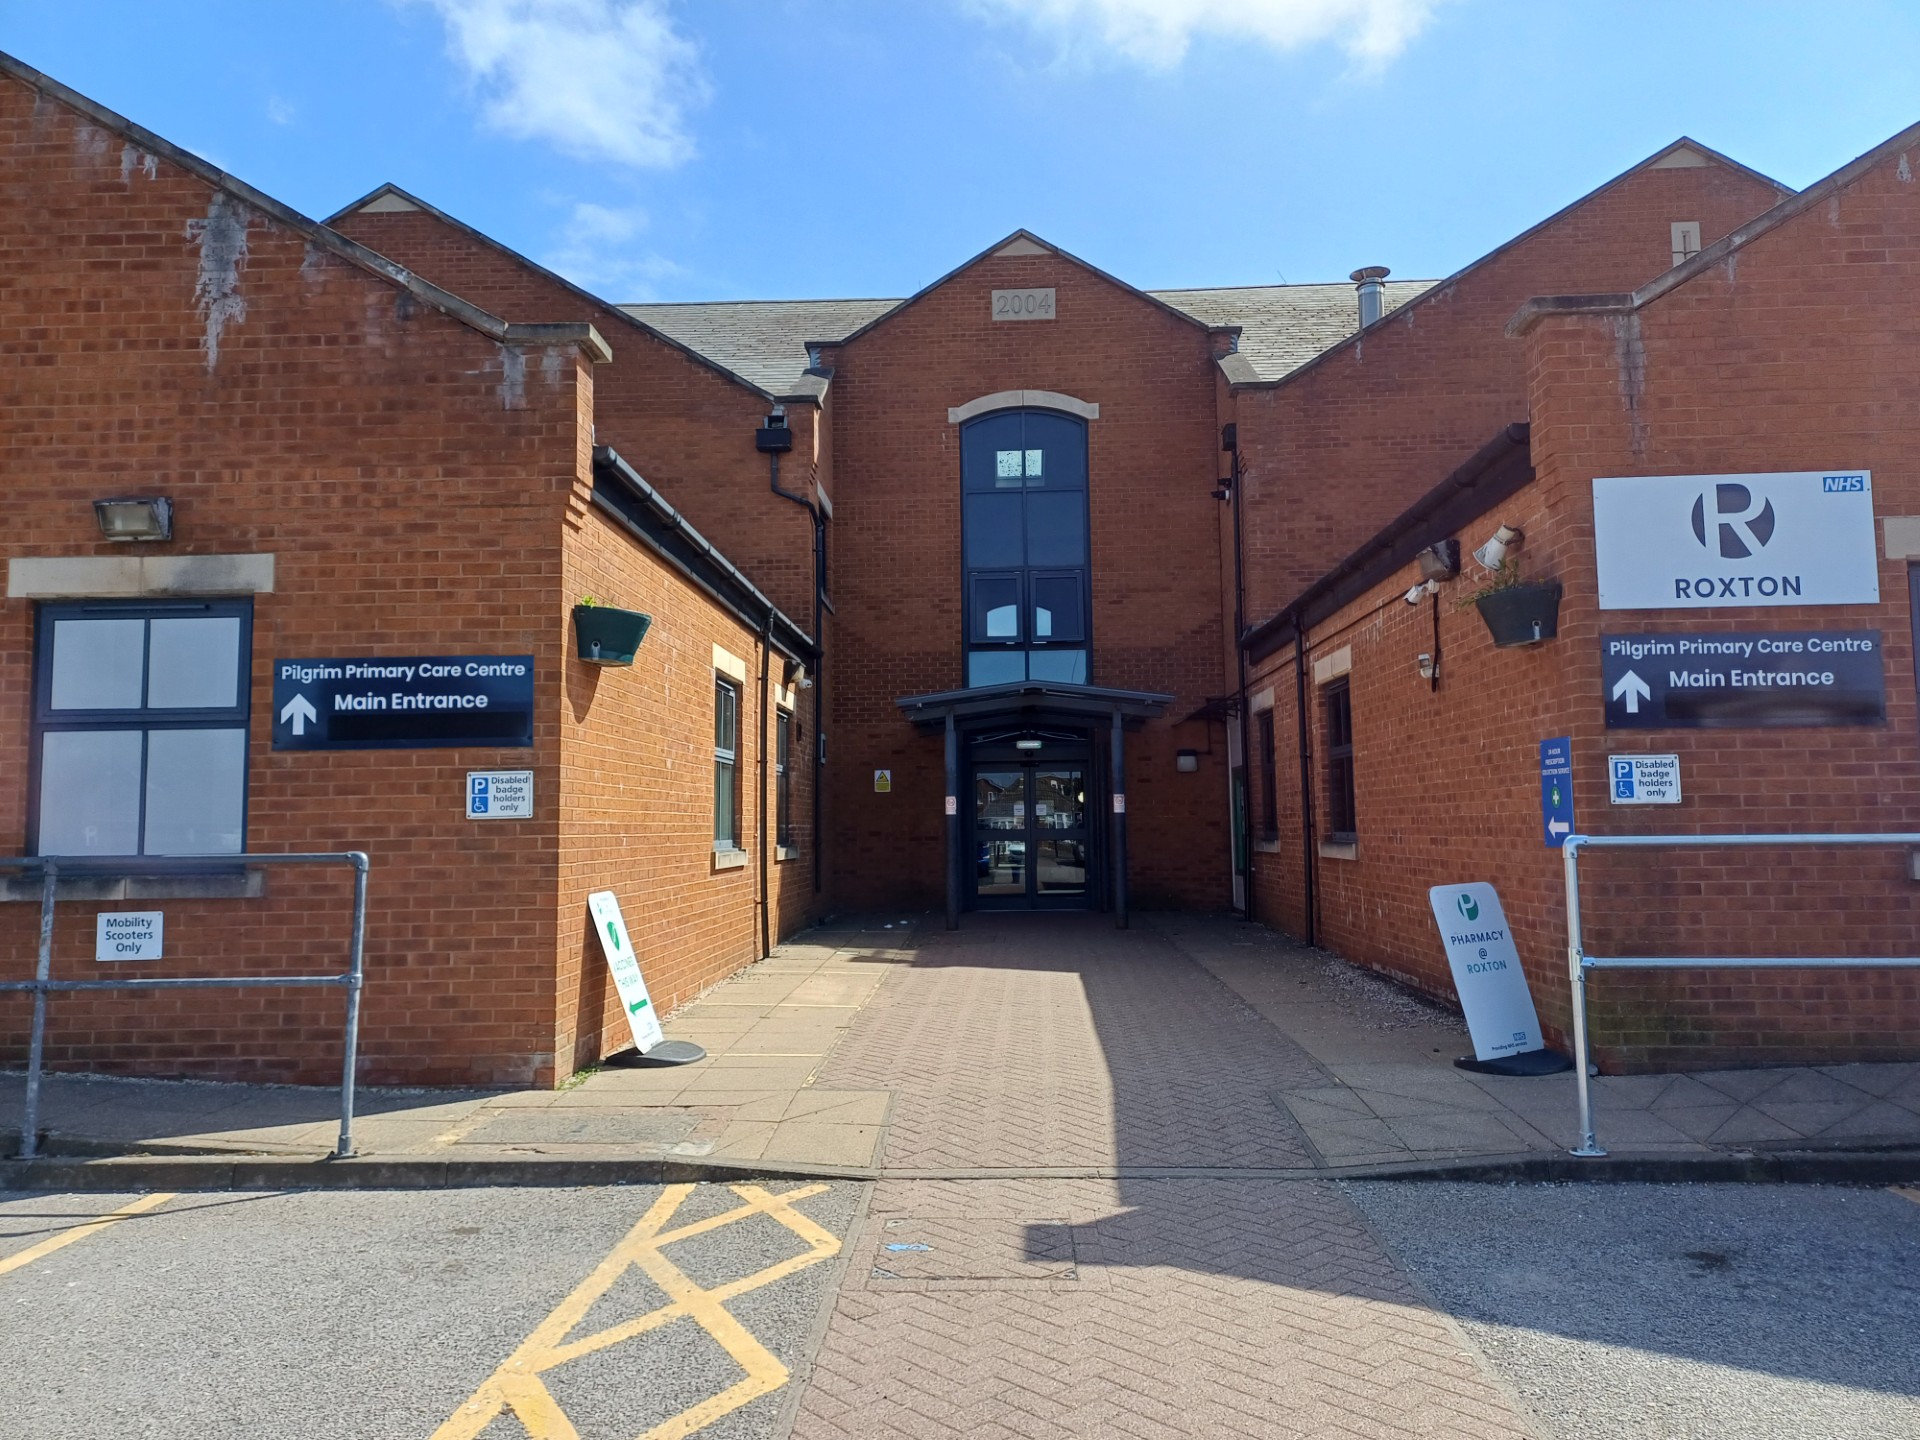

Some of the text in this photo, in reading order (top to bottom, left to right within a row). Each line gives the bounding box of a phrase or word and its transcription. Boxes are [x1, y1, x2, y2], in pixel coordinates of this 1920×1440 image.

[997, 294, 1051, 315] 2004
[1824, 477, 1863, 492] NHS
[1694, 483, 1773, 559] R
[1674, 576, 1802, 599] ROXTON
[1610, 637, 1872, 660] Pilgrim Primary Care Centre
[281, 662, 526, 684] Pilgrim Primary Care Centre
[1669, 668, 1834, 687] Main Entrance
[334, 692, 488, 710] Main Entrance
[1635, 760, 1674, 768] Disabled
[491, 776, 528, 784] Disabled
[1641, 770, 1670, 779] badge
[1639, 779, 1673, 787] holders
[496, 785, 523, 794] badge
[1646, 788, 1666, 798] only
[500, 803, 519, 812] only
[106, 917, 152, 929] Mobility
[106, 931, 153, 940] Scooters
[1450, 930, 1504, 945] PHARMACY
[116, 942, 142, 954] Only
[1478, 948, 1488, 959] @
[1467, 960, 1507, 974] ROXTON
